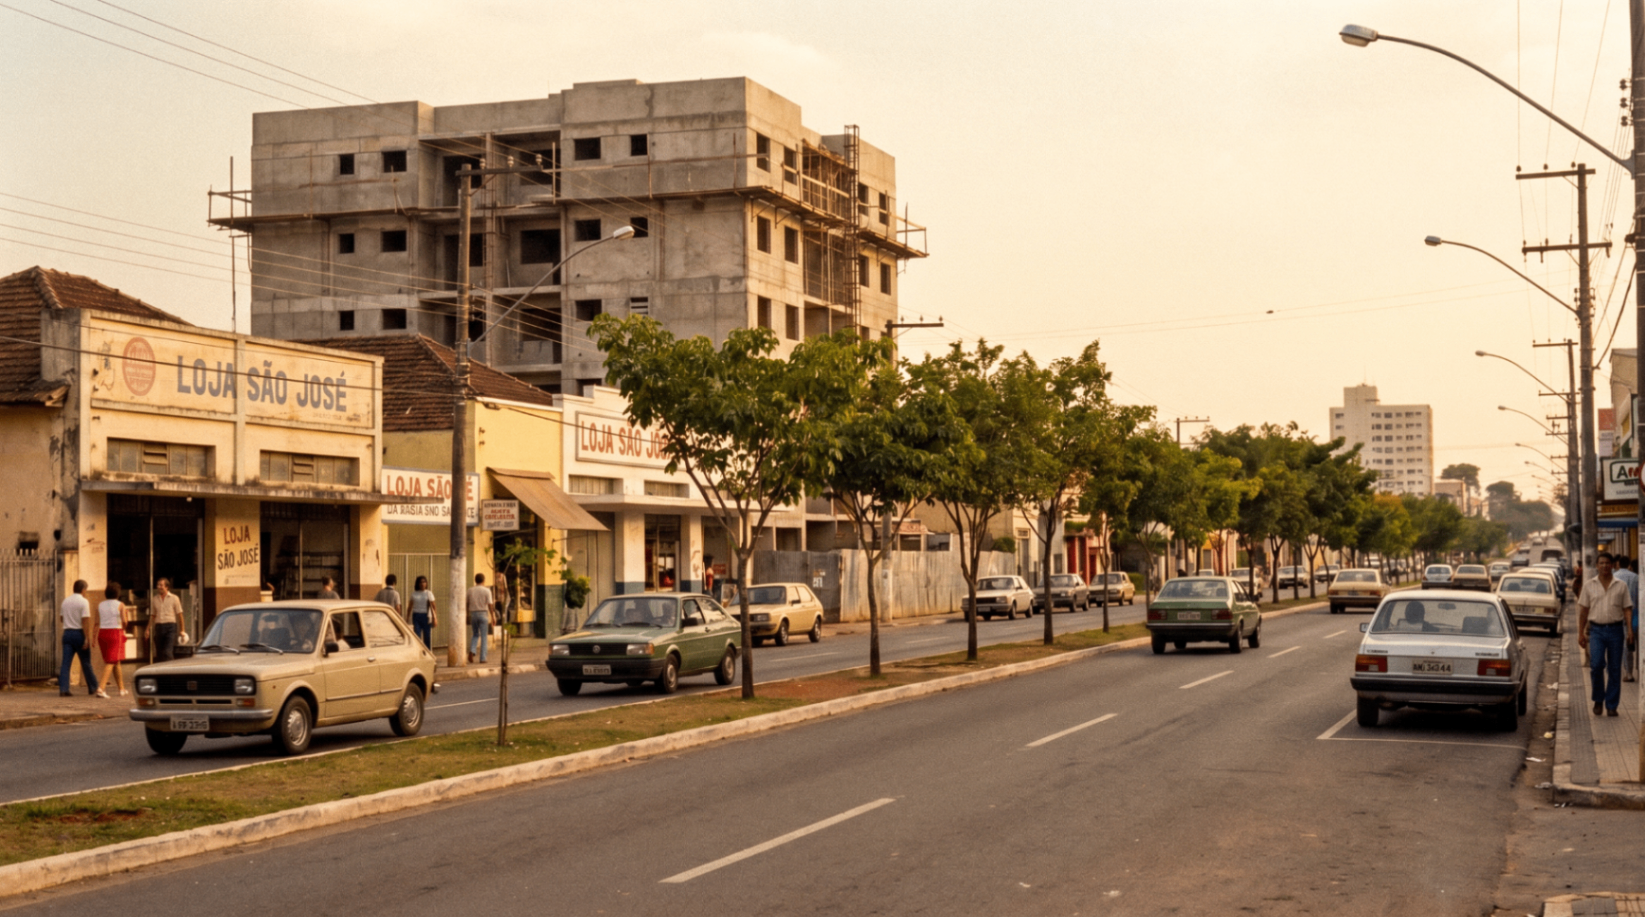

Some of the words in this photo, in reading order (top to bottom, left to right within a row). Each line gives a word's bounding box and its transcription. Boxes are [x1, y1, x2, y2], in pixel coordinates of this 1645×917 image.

[177, 355, 237, 399] LOJA
[247, 360, 288, 405] SÃO
[296, 370, 347, 412] JOSÉ
[581, 421, 614, 454] LOJA
[619, 421, 642, 457] SÃO
[387, 475, 422, 497] LOJA
[427, 475, 452, 500] SÃO
[223, 525, 251, 545] LOJA
[217, 549, 235, 571] SÃO
[237, 543, 259, 567] JOSÉ
